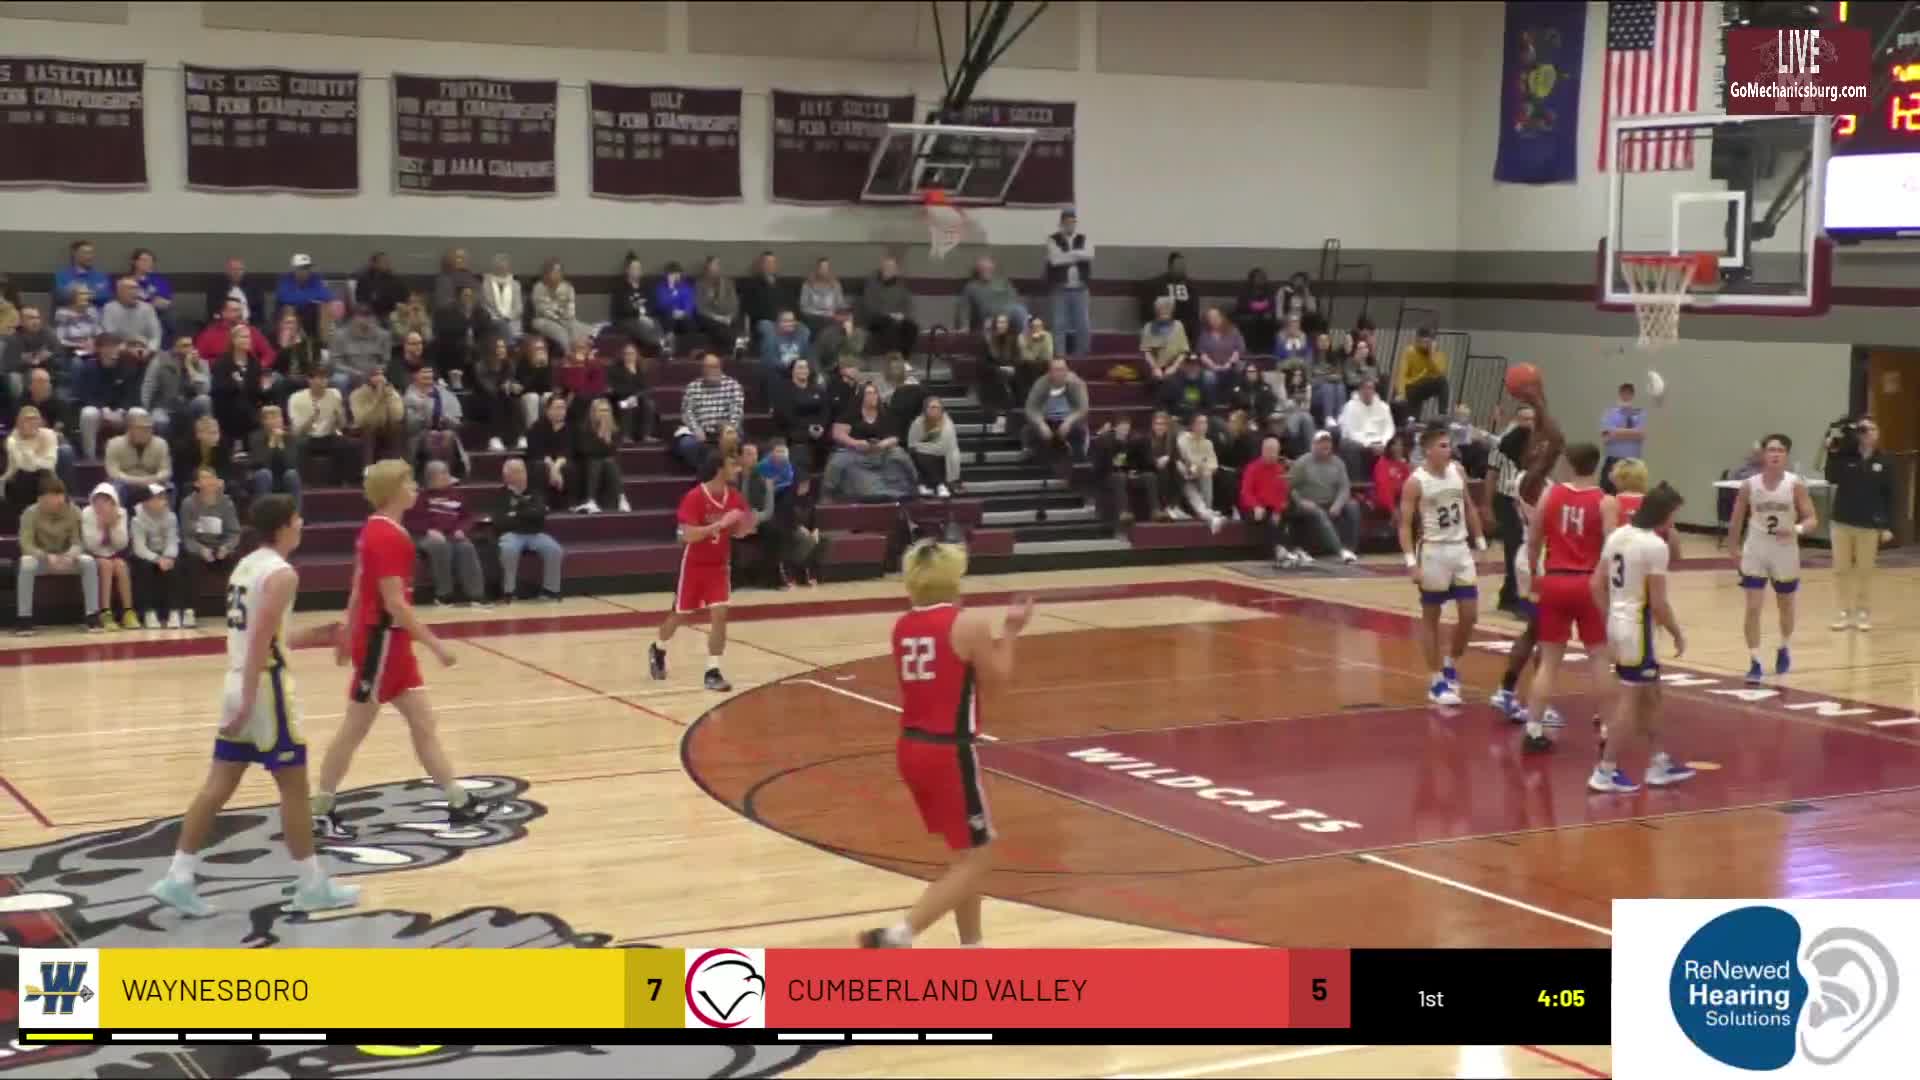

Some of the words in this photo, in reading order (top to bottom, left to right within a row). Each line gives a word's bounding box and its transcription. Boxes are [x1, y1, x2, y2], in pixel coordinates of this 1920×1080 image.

[25, 63, 138, 87] BASKETBALL
[1612, 553, 1625, 588] 3
[901, 637, 936, 680] 22
[1066, 746, 1363, 833] WILDCATS
